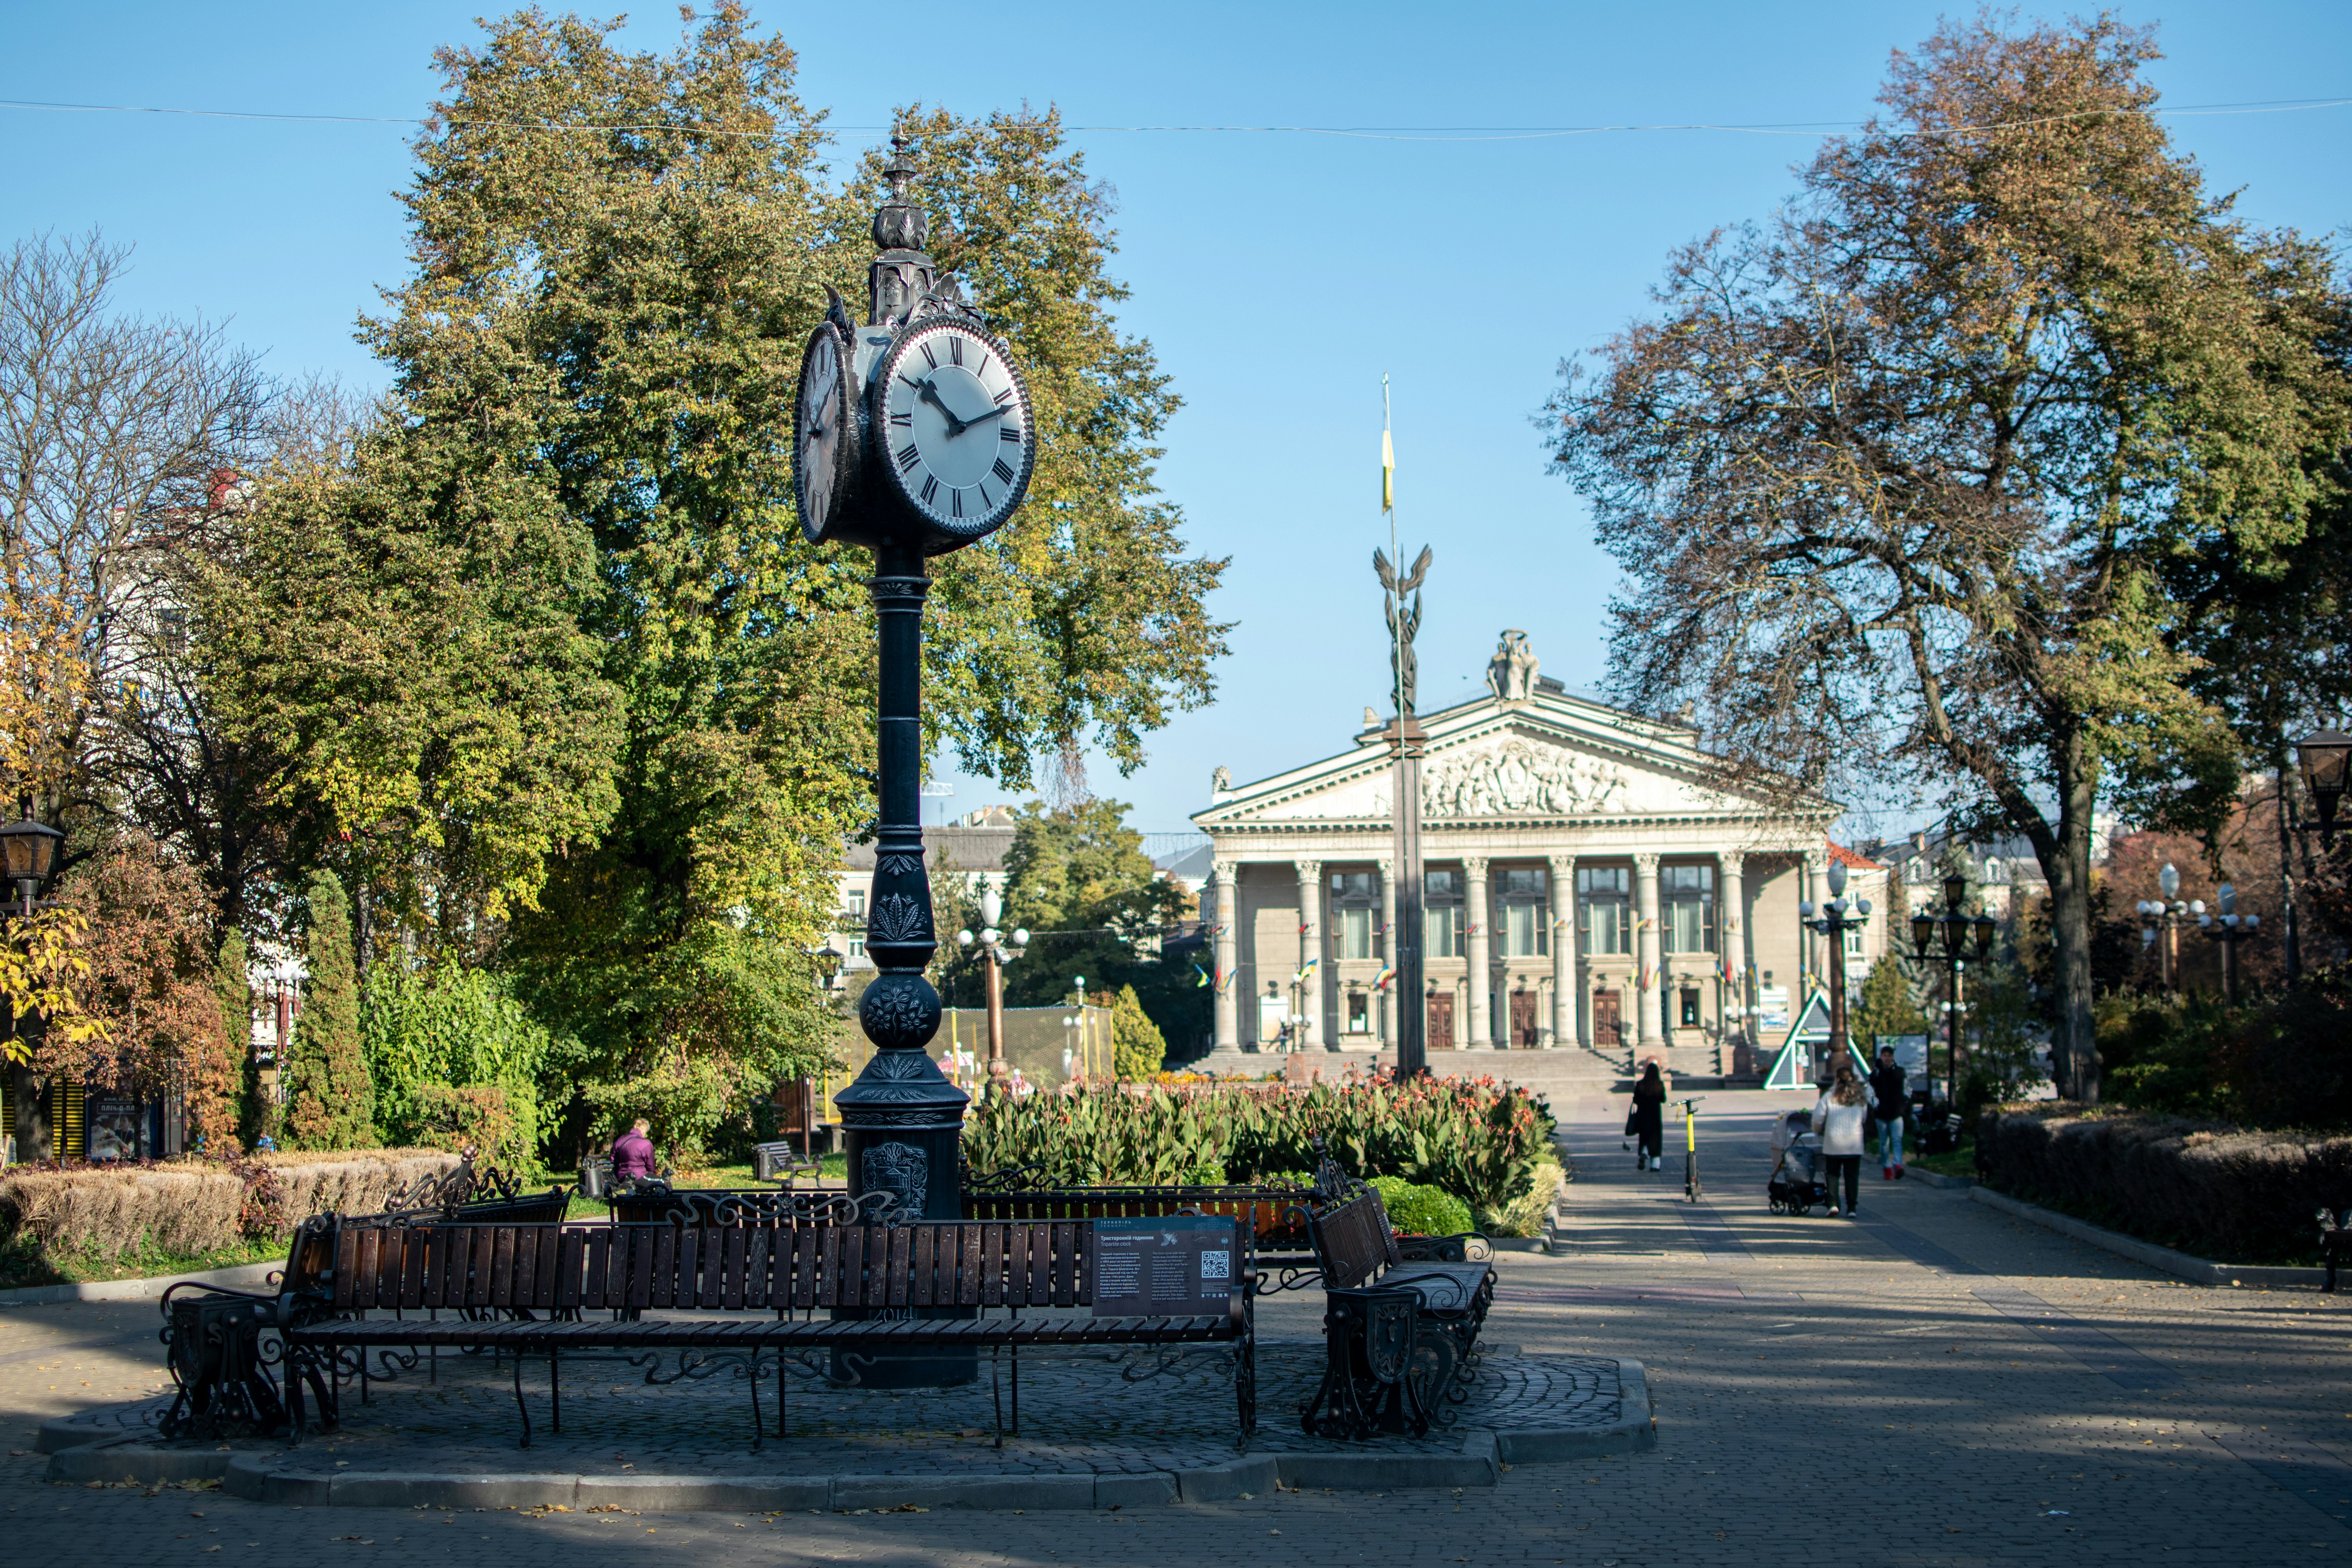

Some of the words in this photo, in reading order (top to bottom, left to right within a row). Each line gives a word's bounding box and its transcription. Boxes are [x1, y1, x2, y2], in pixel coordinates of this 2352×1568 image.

[919, 341, 938, 372] XI
[949, 336, 964, 366] XII
[978, 353, 989, 377] I
[994, 387, 1013, 406] II
[1000, 427, 1020, 443] III
